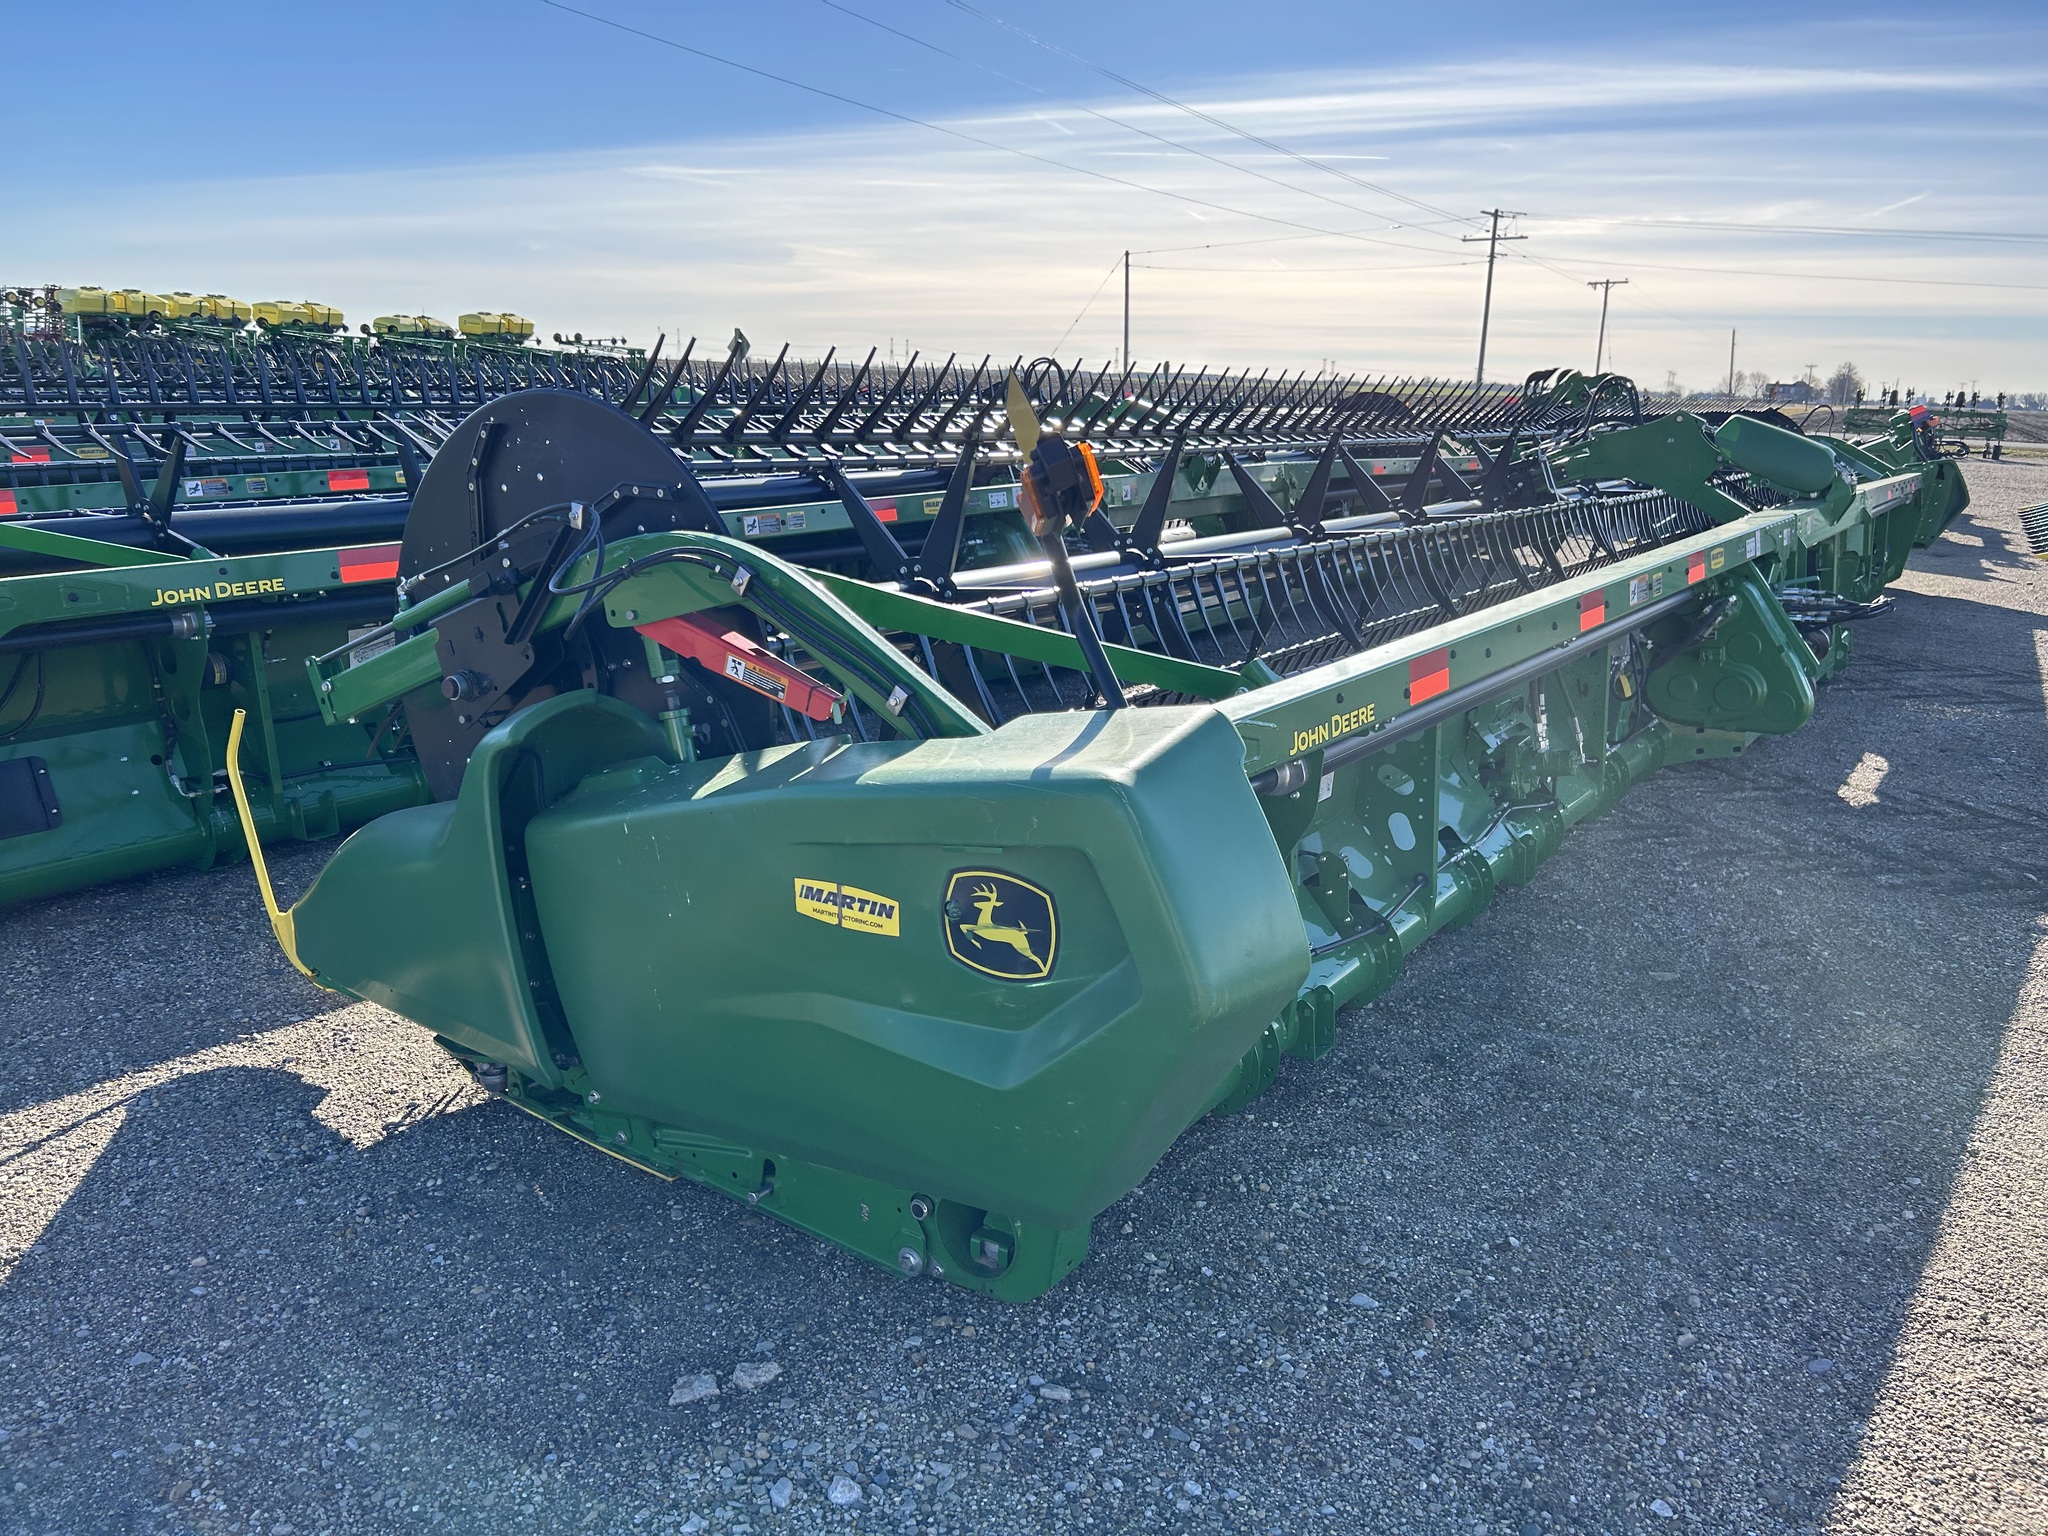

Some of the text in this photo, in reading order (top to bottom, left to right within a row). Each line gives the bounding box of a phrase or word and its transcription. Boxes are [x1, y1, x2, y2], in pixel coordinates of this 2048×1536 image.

[151, 577, 286, 606] JOHN DEERE
[1289, 702, 1376, 757] JOHN DEERE
[803, 885, 896, 920] MARTIN
[812, 906, 884, 930] MARTINTACTORINC.COM
